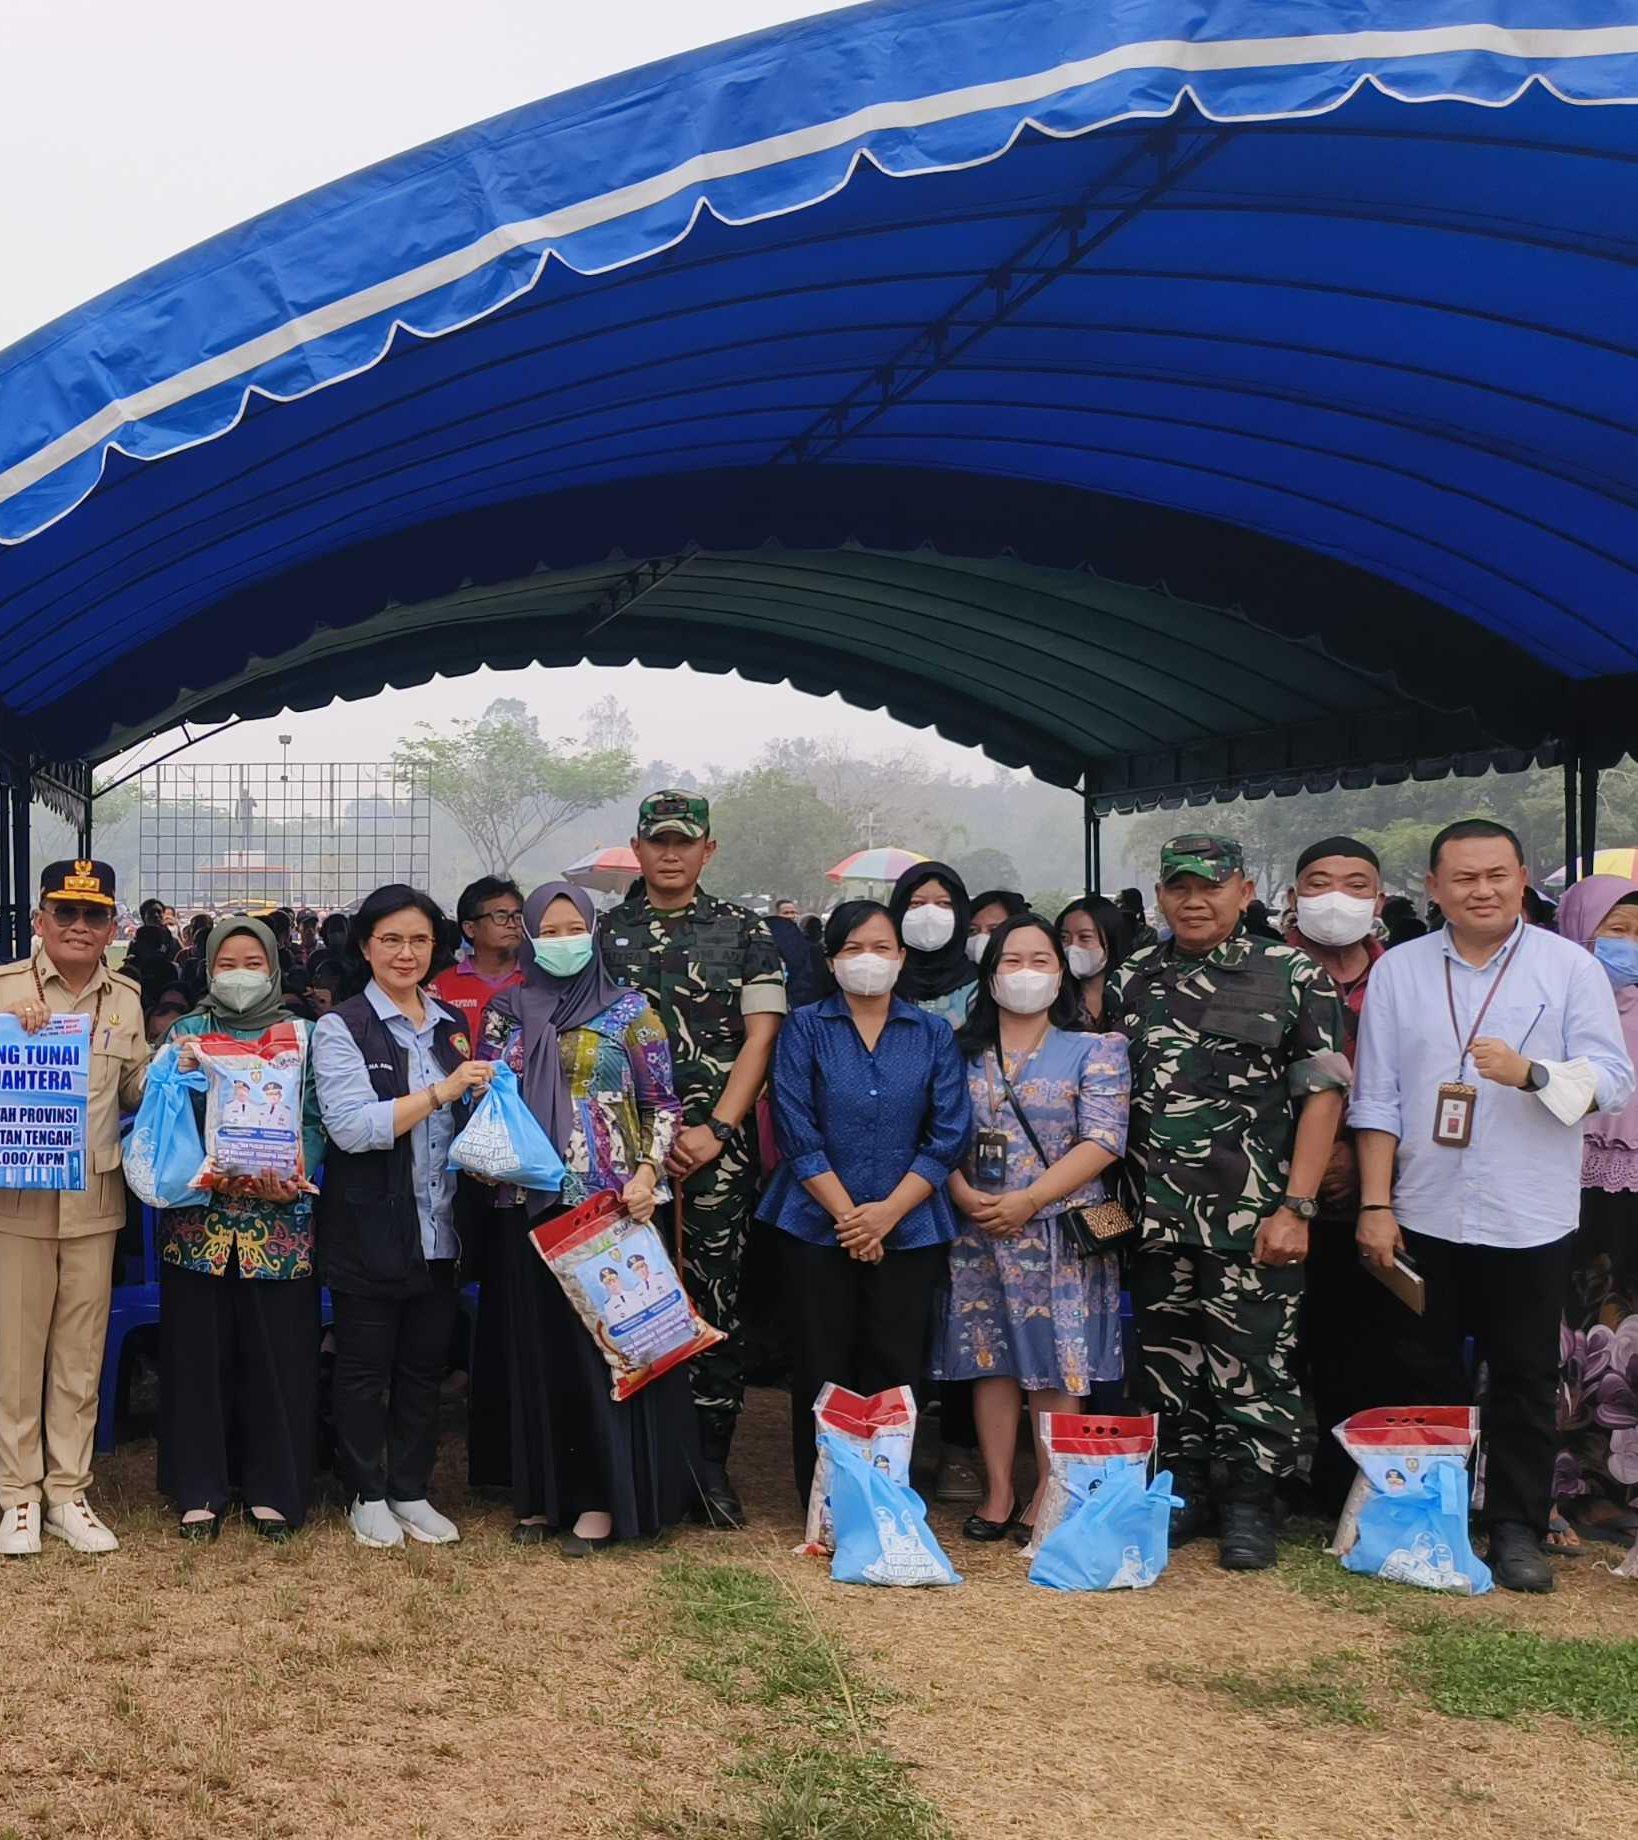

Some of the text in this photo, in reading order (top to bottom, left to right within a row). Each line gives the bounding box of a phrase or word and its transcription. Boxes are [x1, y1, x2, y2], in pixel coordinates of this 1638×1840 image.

[24, 1045, 79, 1065] TUNAI
[20, 1107, 77, 1123] PROVINSI
[25, 1129, 72, 1145] TENGAH
[37, 1152, 64, 1165] KPM
